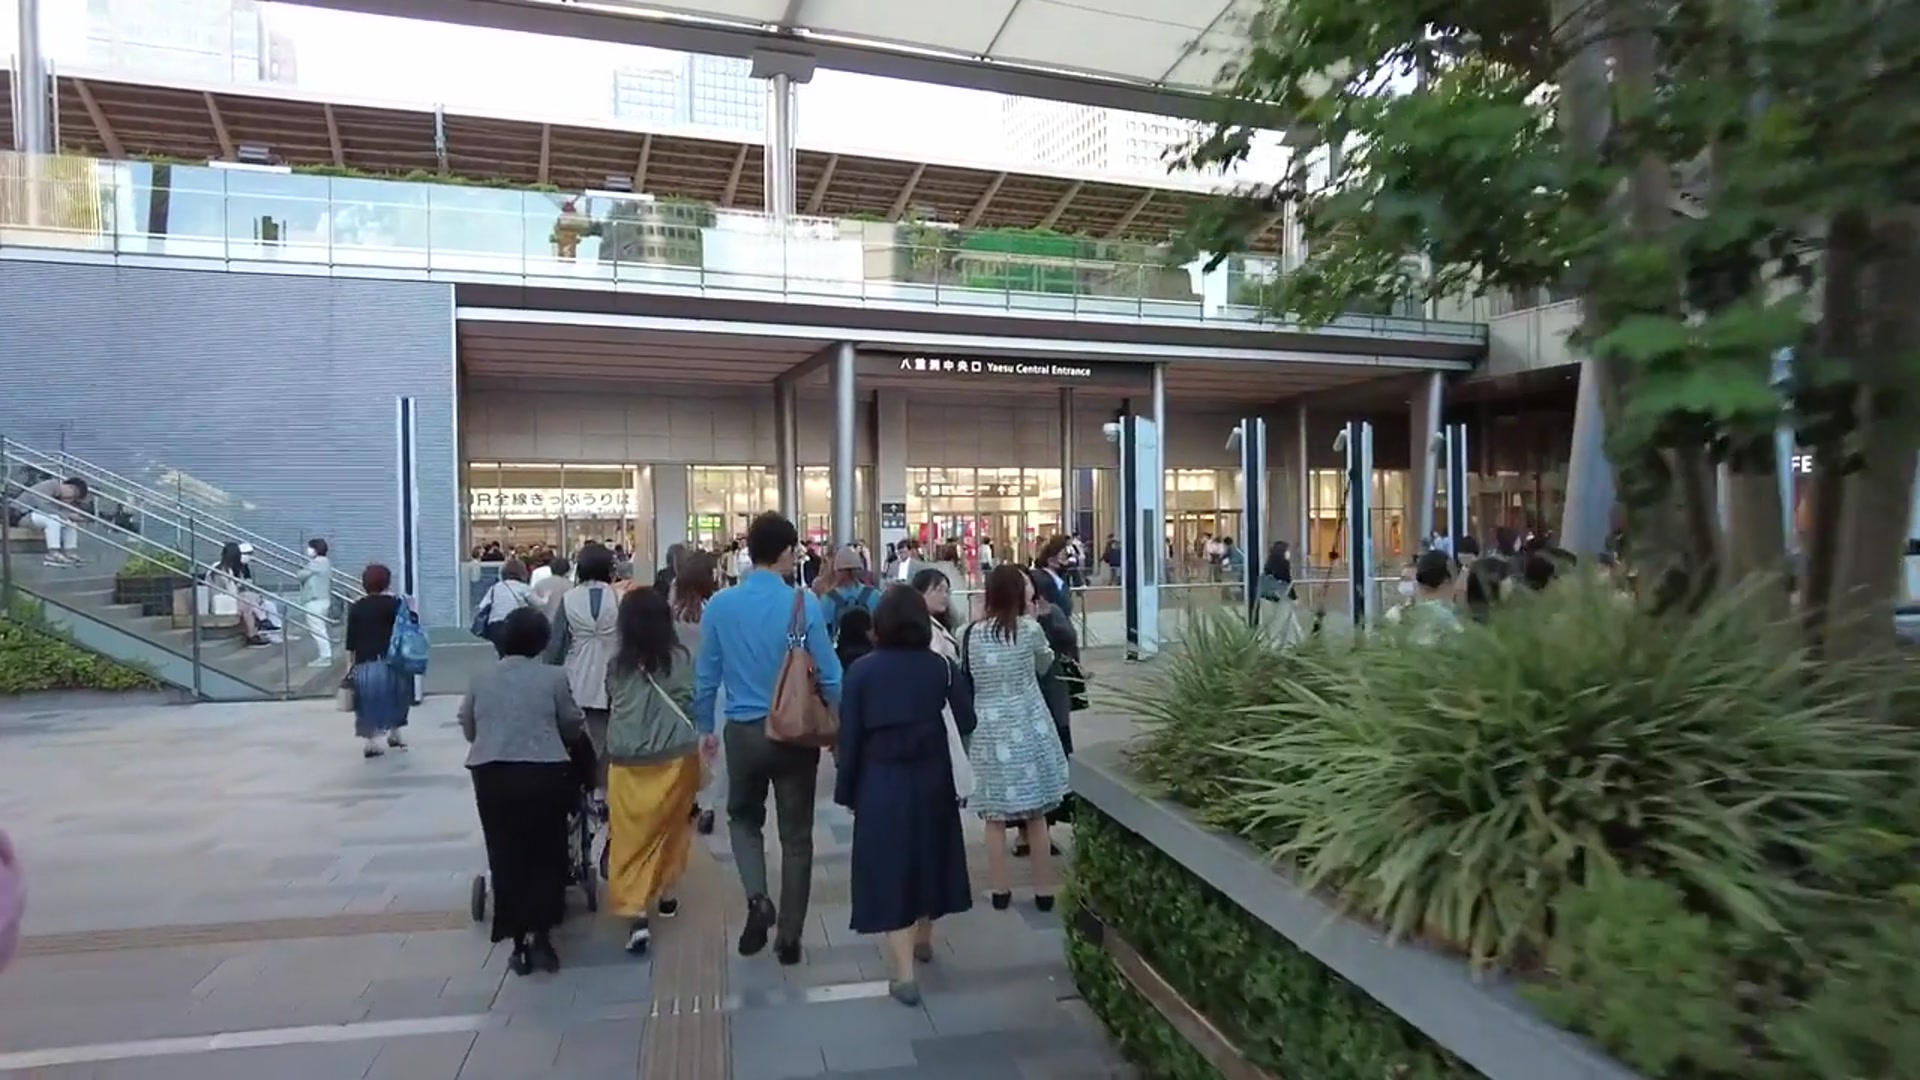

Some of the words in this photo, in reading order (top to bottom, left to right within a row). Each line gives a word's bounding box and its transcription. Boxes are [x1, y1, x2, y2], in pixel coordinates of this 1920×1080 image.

[986, 362, 1014, 373] Yaesu
[1016, 363, 1050, 374] Central
[1051, 365, 1091, 376] Entrance
